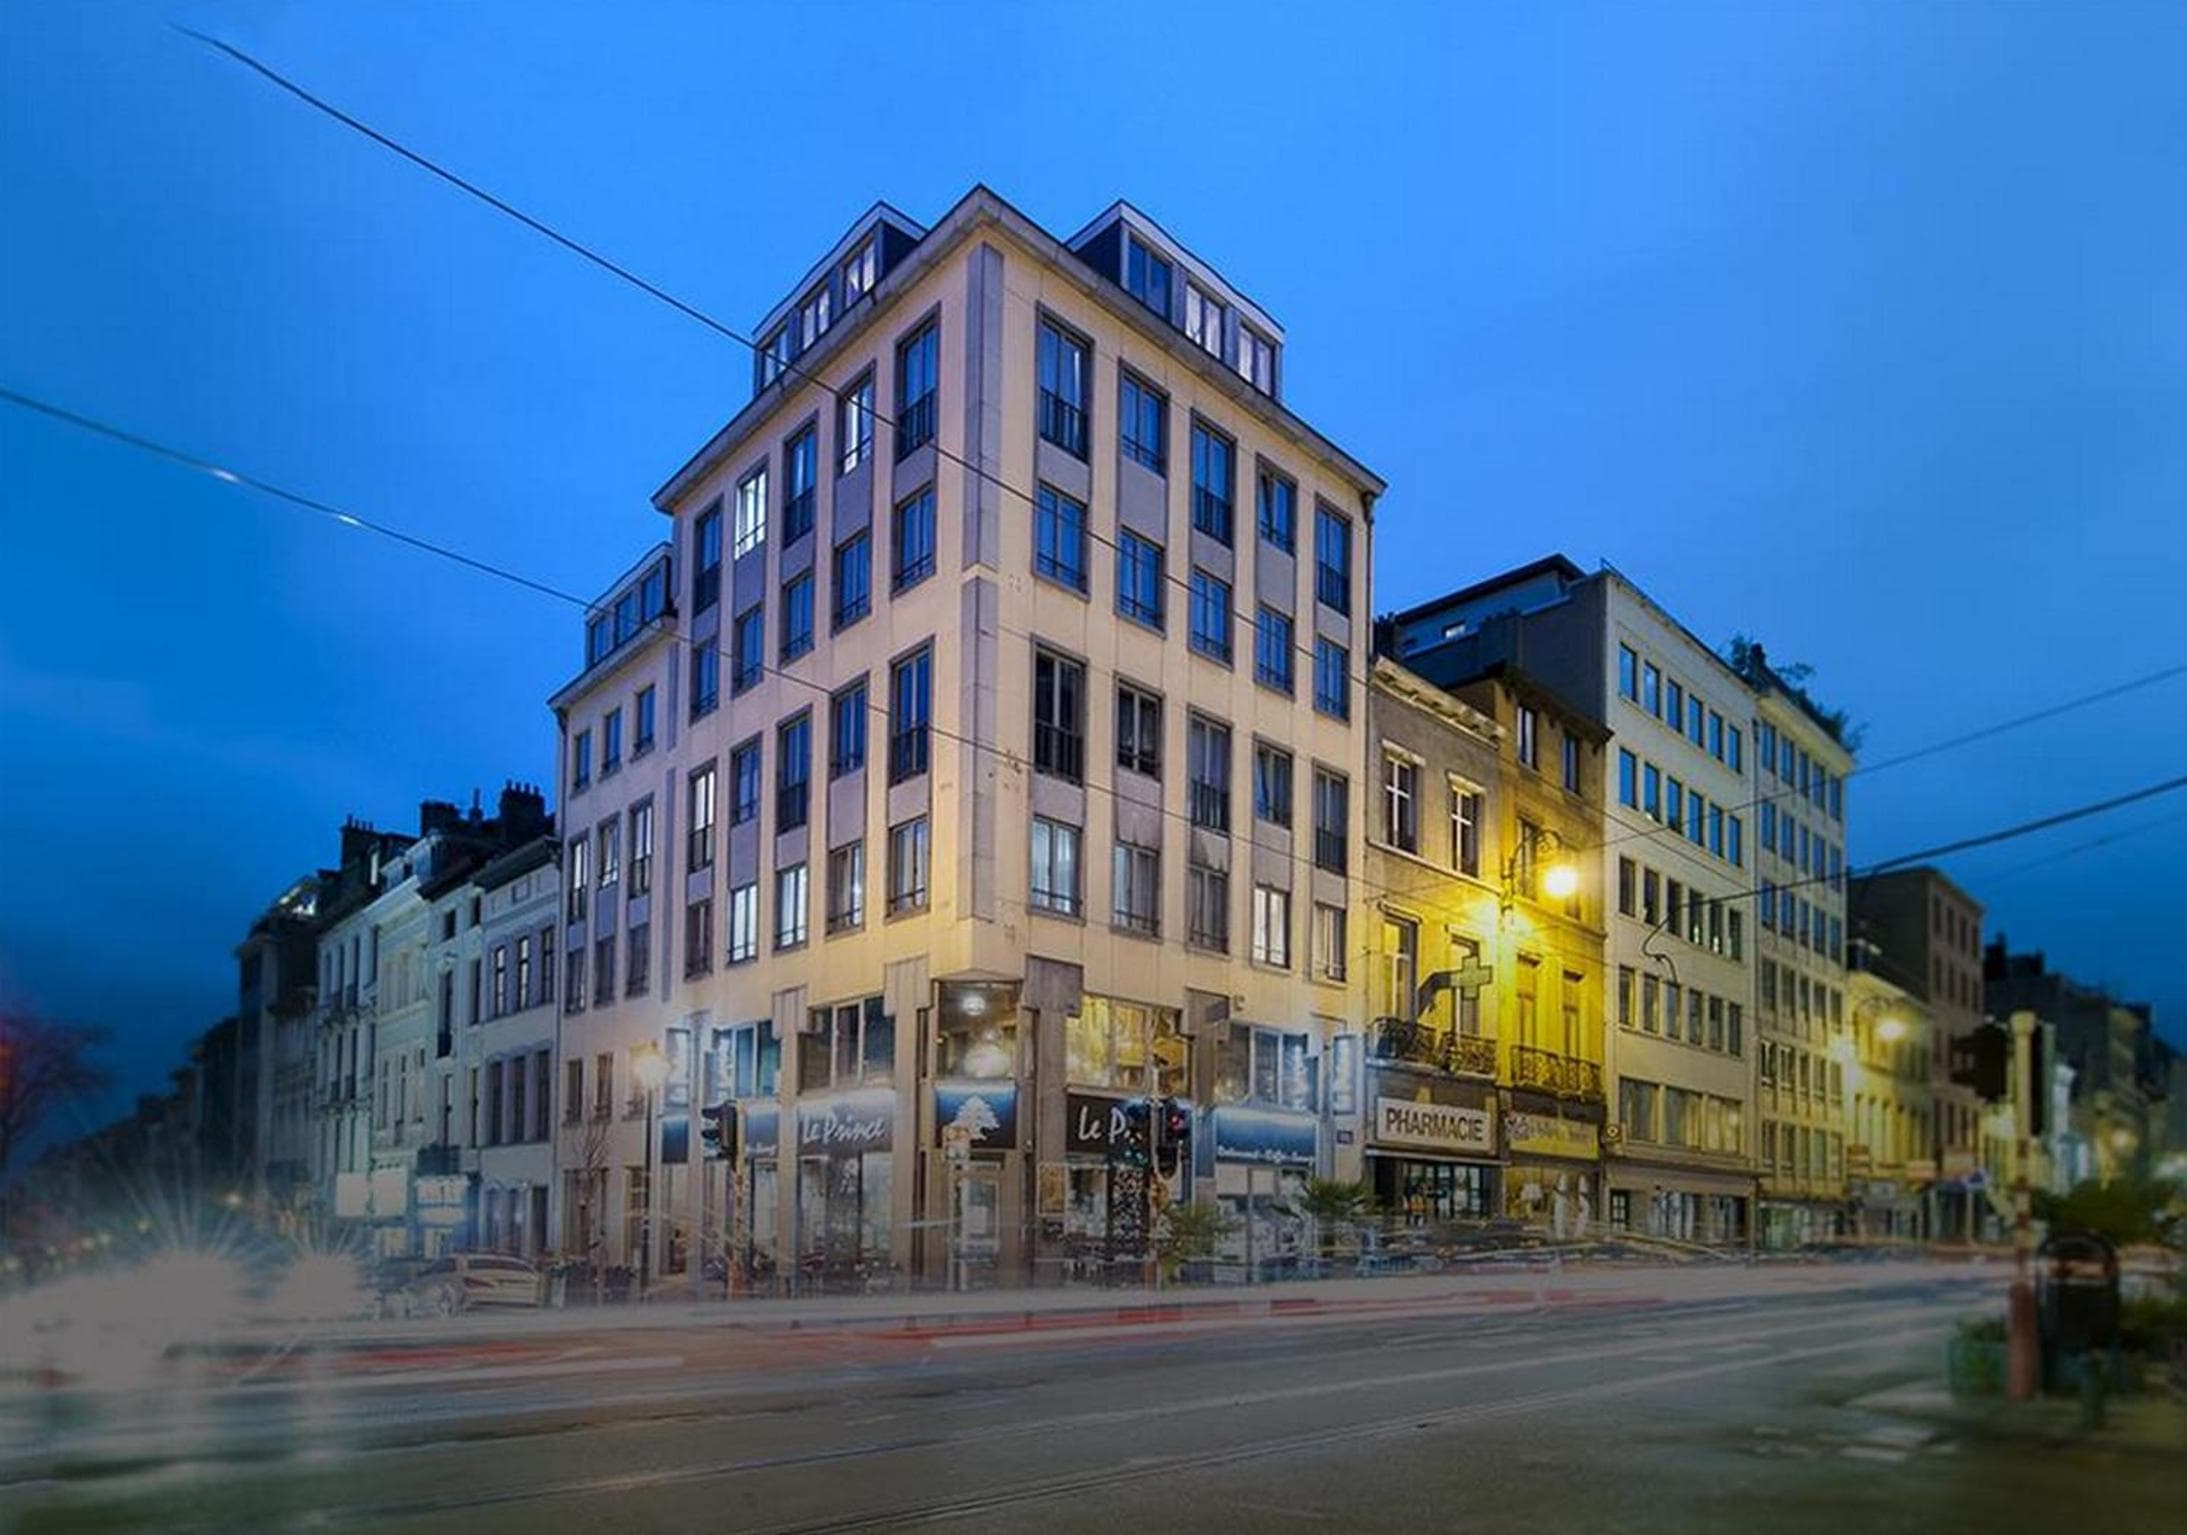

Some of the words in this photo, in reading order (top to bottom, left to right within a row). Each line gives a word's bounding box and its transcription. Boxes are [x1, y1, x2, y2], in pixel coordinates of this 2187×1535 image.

[803, 1114, 820, 1143] Le
[1078, 1105, 1102, 1141] Le
[1385, 1107, 1483, 1141] PHARMACIE
